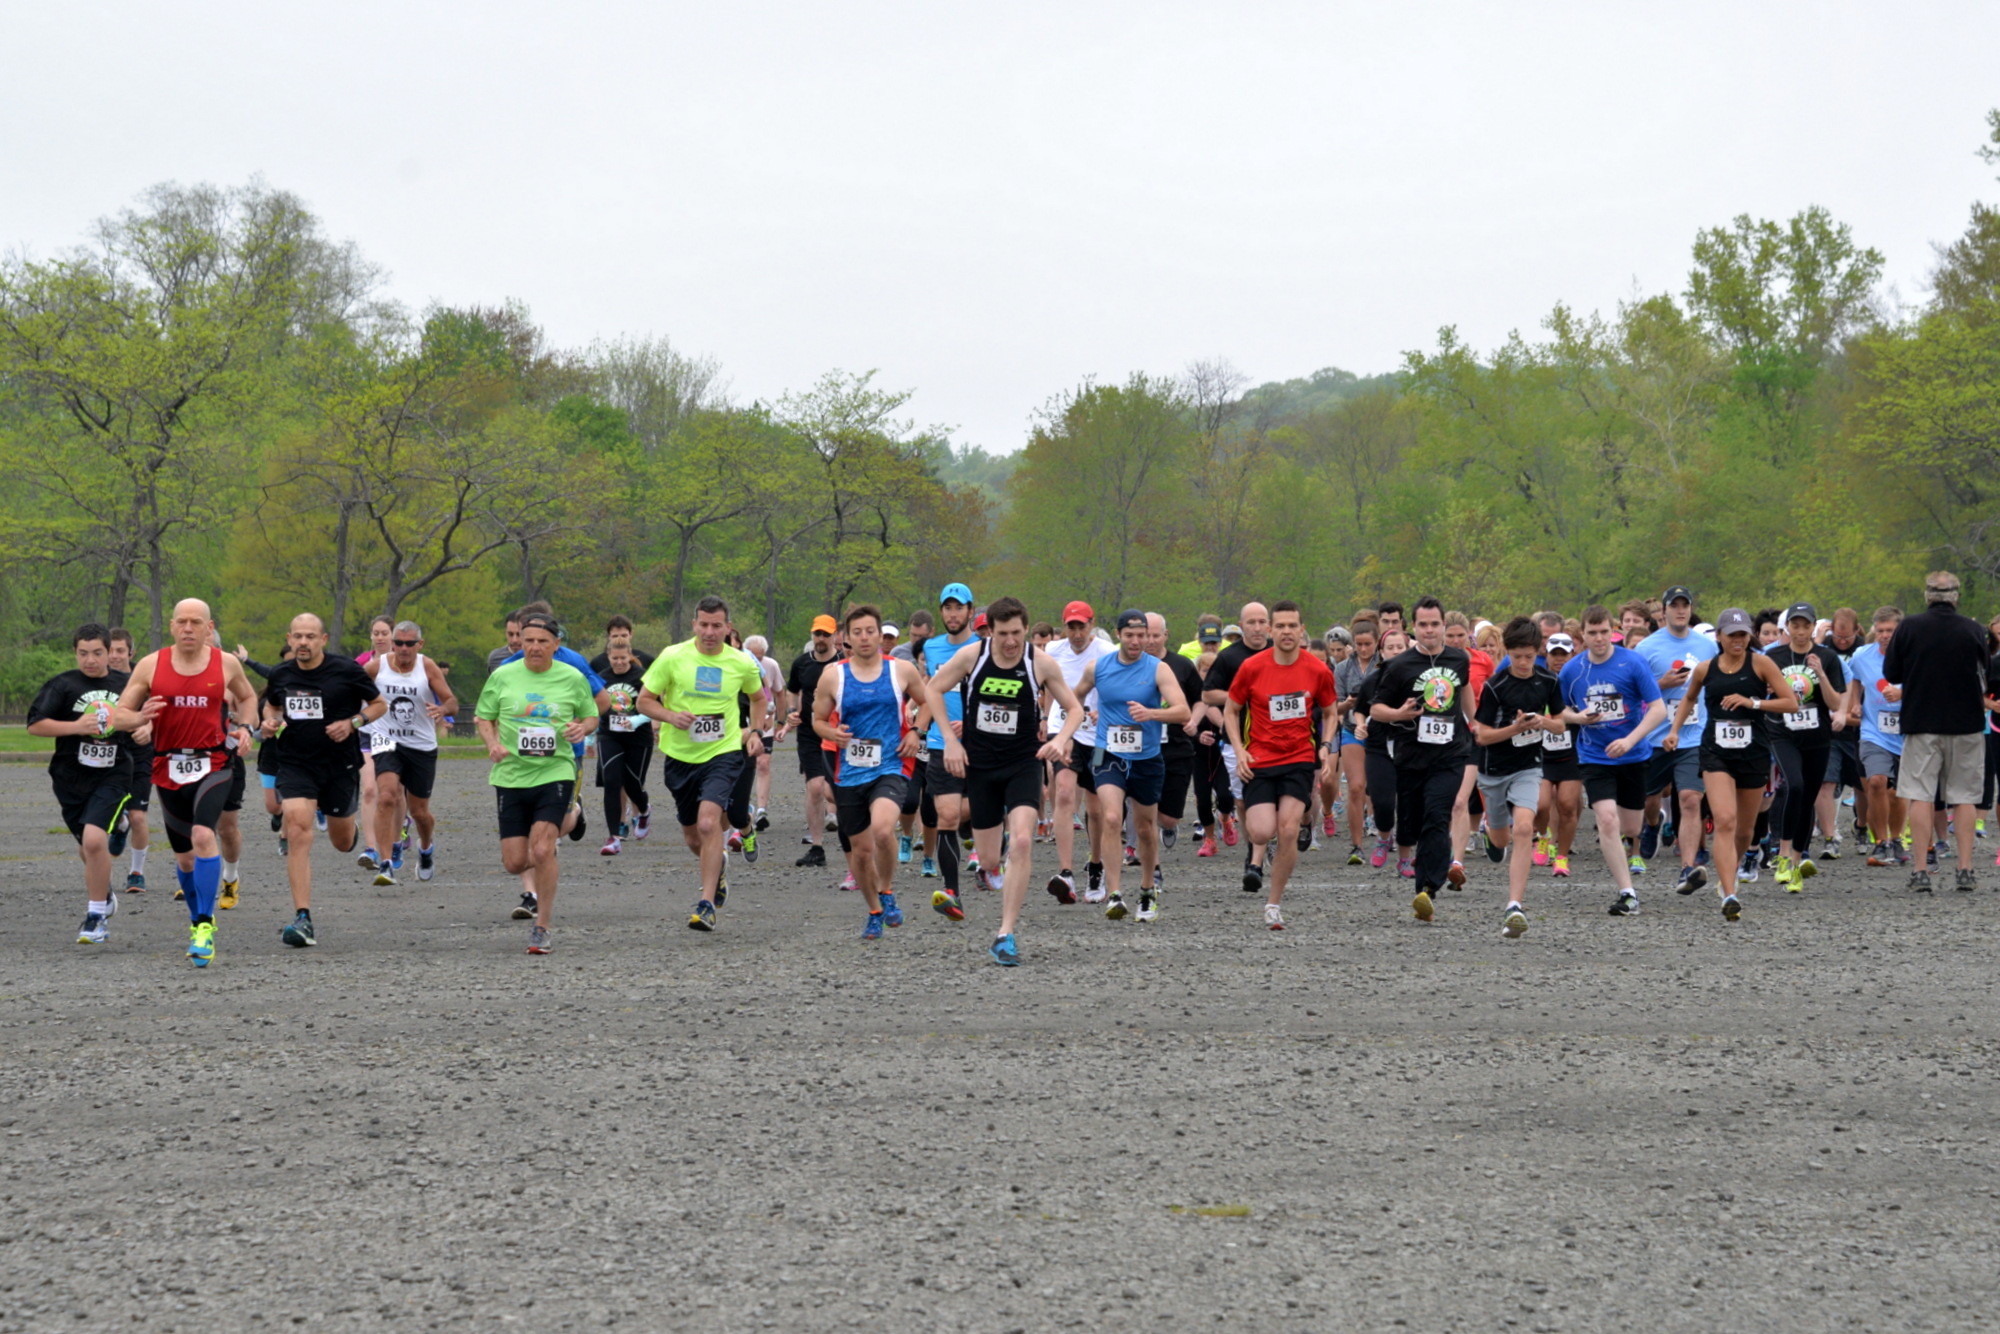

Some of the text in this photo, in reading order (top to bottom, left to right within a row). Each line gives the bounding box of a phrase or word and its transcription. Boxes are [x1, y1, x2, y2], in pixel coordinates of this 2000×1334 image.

[386, 685, 417, 696] TEAM
[174, 696, 209, 708] RRR
[288, 698, 320, 711] 6736
[1275, 699, 1299, 712] 398
[1594, 700, 1618, 713] 290
[983, 710, 1010, 724] 360
[1790, 710, 1811, 722] 191
[1883, 717, 1899, 727] 19
[388, 728, 415, 737] PAUL
[694, 720, 720, 734] 208
[1425, 722, 1448, 735] 193
[1722, 727, 1745, 739] 190
[521, 736, 555, 749] 0669
[1113, 732, 1136, 744] 165
[82, 744, 115, 758] 6938
[851, 745, 874, 757] 397
[176, 760, 203, 774] 403
